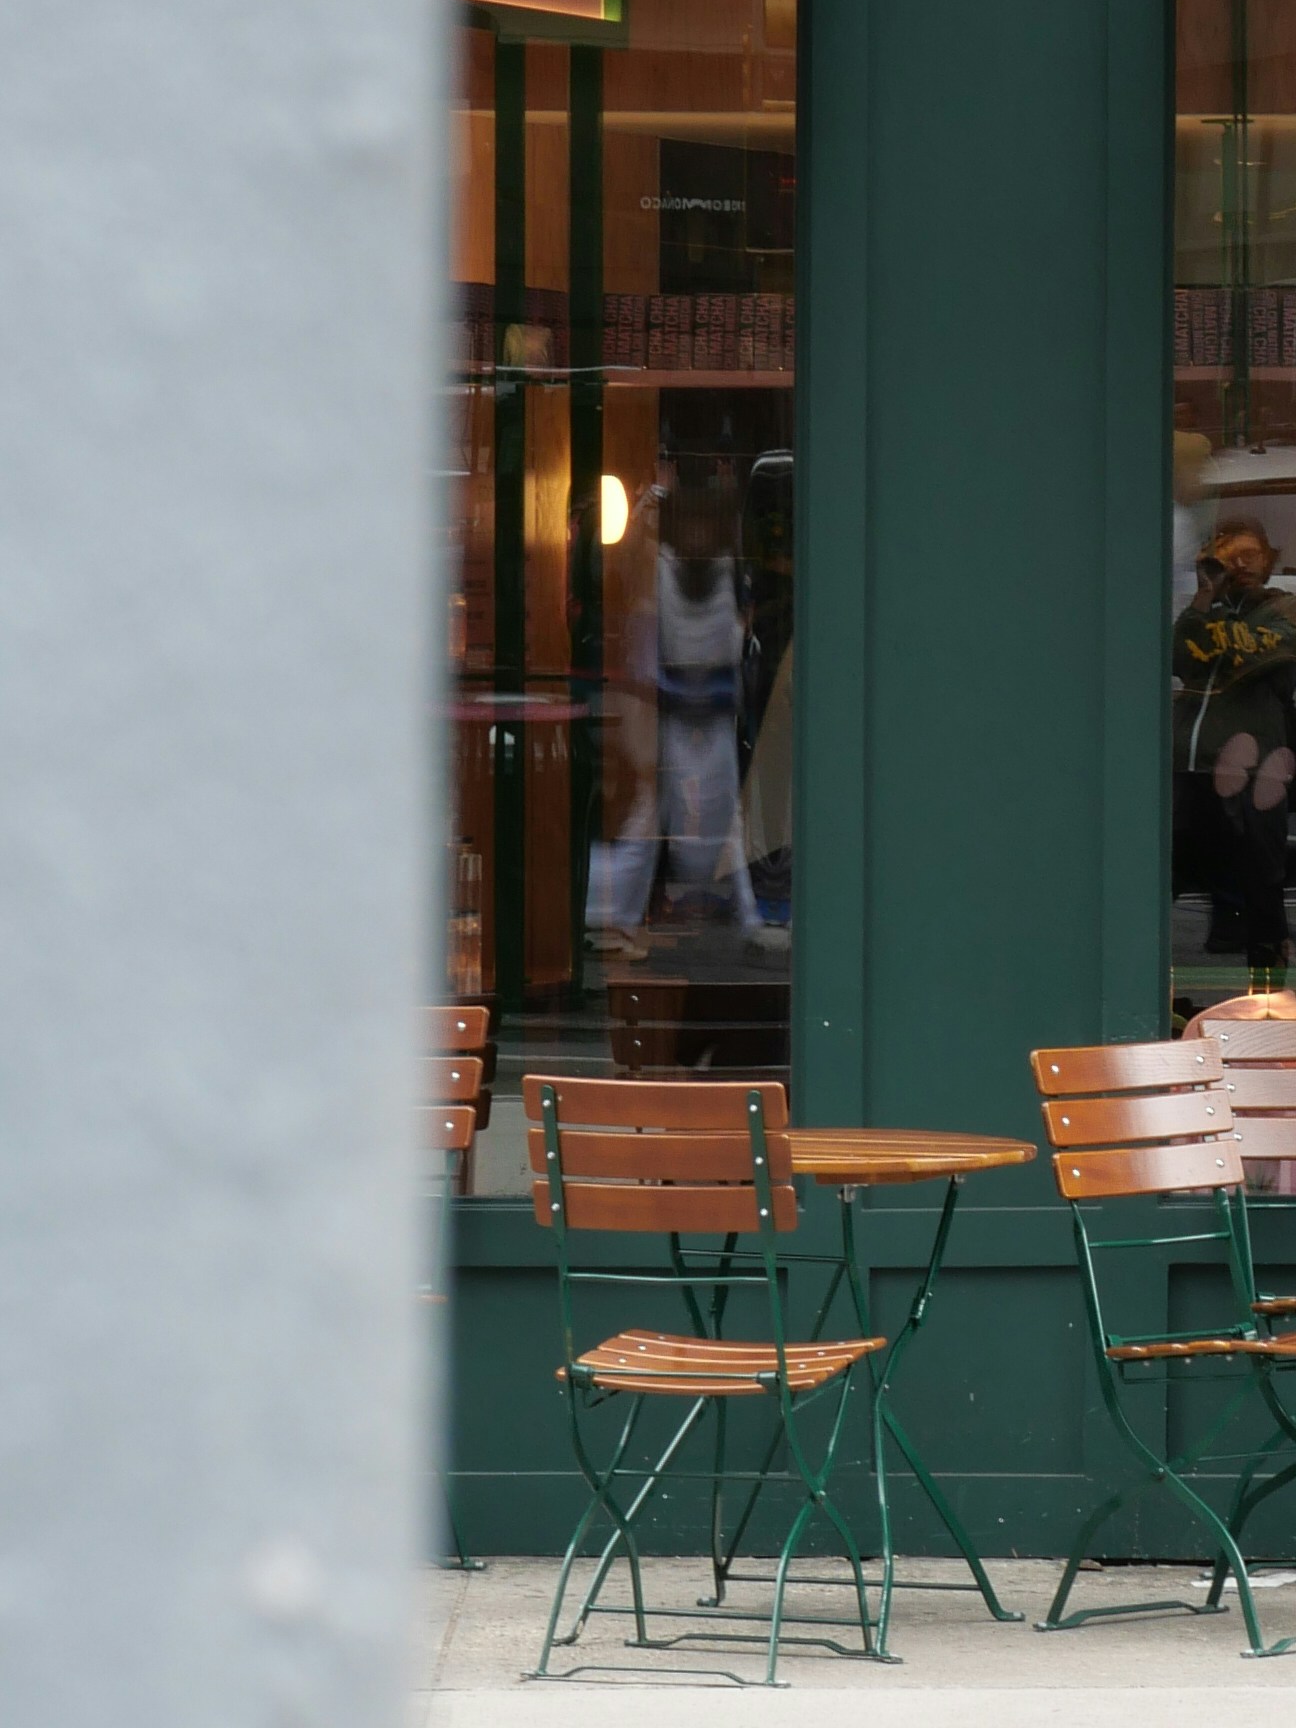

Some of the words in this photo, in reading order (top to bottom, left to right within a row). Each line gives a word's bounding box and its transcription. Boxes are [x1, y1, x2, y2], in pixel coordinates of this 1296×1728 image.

[618, 295, 633, 353] MATCHA
[651, 296, 664, 323] CHA
[664, 297, 679, 353] MATCHA
[697, 295, 709, 323] CHA
[710, 296, 724, 353] MATCHA
[755, 296, 769, 353] MATCHA
[1175, 292, 1189, 351] MATCHA
[1284, 307, 1296, 365] MATCHA
[649, 328, 662, 354] CHA
[696, 328, 708, 354] CHA
